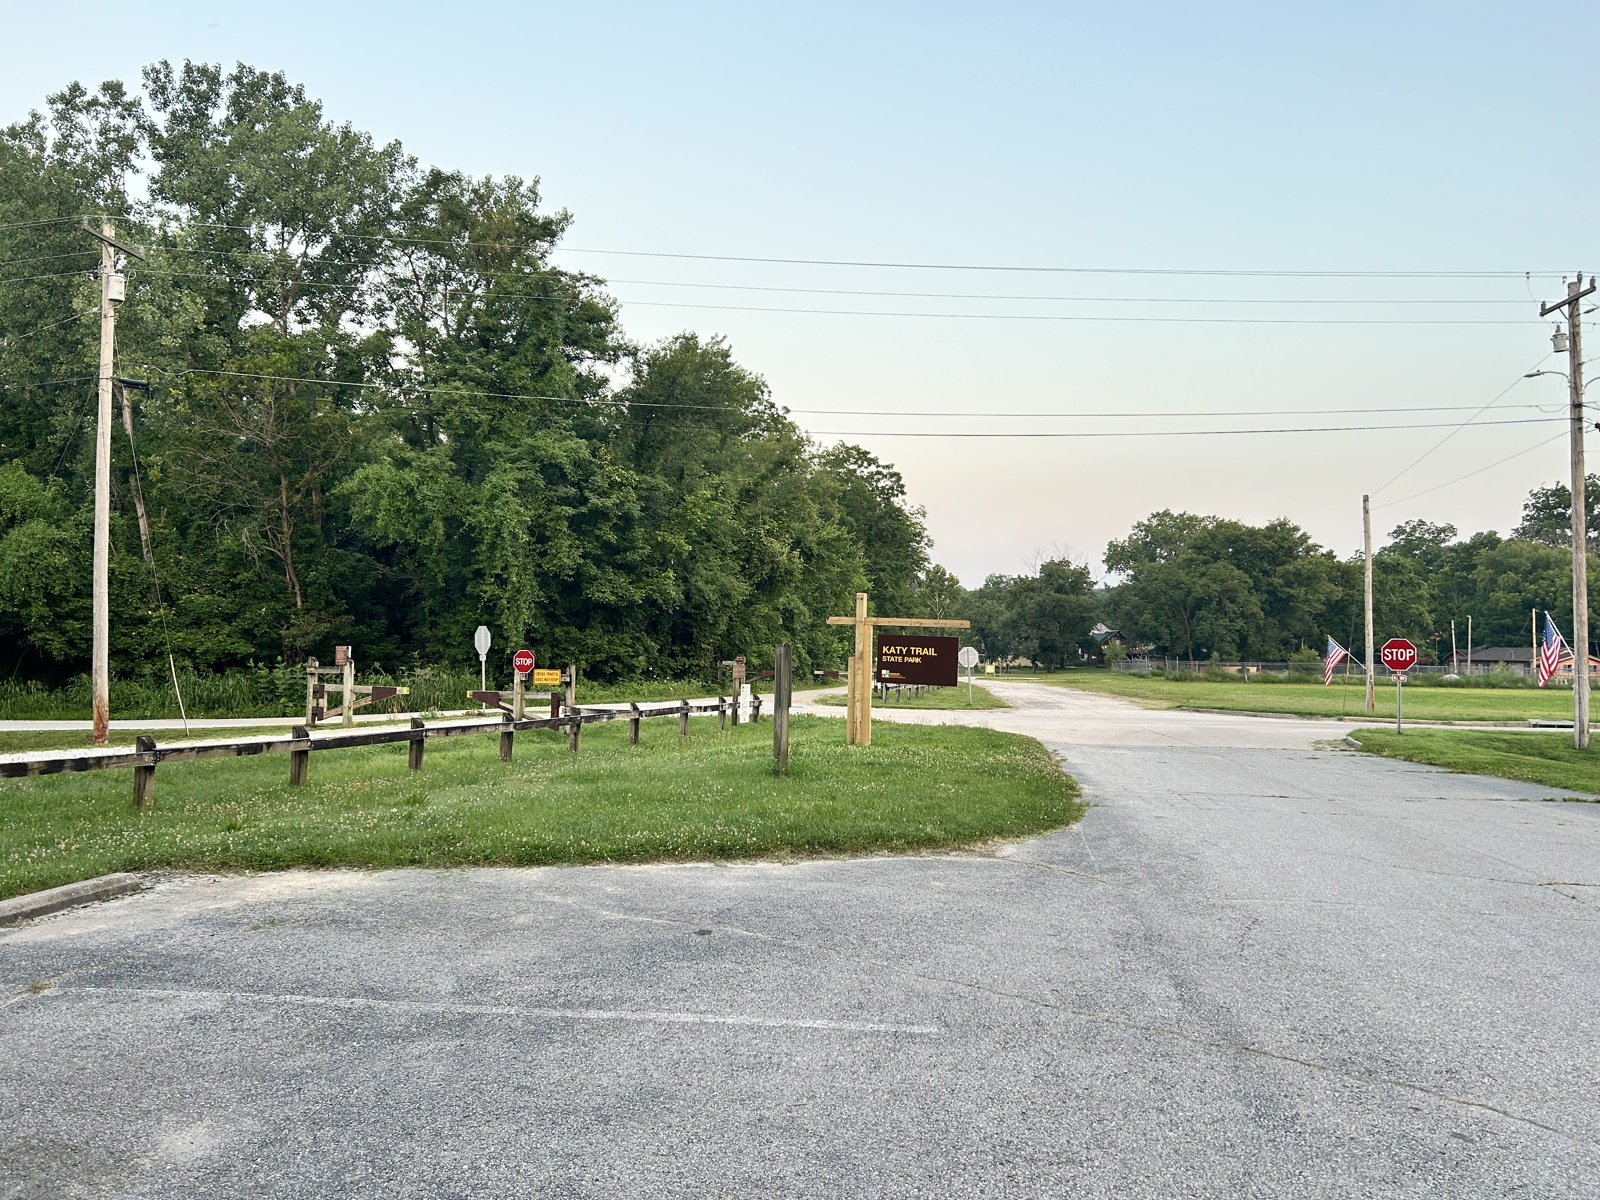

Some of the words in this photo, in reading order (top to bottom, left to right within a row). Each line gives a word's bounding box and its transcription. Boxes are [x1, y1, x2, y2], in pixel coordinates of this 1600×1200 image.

[882, 645, 908, 655] KATY
[909, 647, 938, 656] TRAIL
[1384, 648, 1414, 661] STOP
[515, 657, 533, 666] STOP
[882, 655, 903, 663] STATE
[904, 656, 922, 664] PARK
